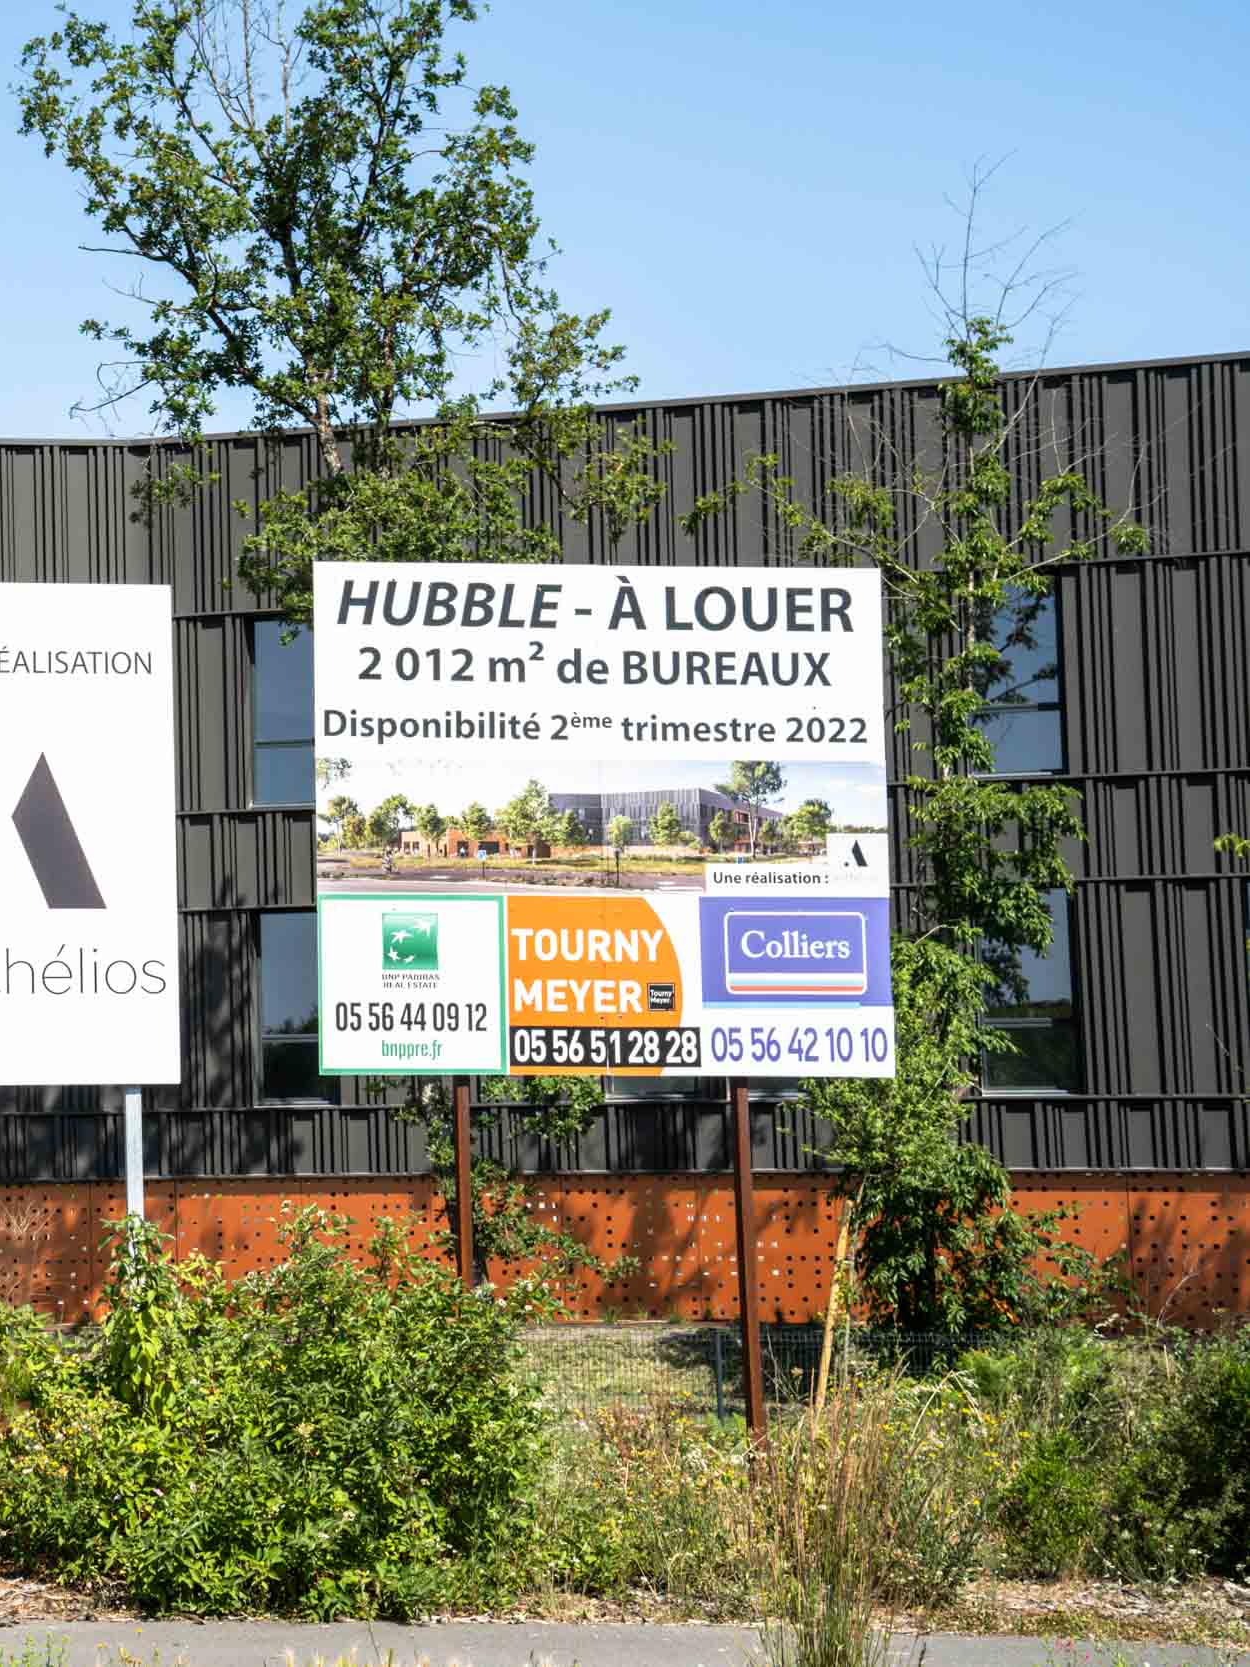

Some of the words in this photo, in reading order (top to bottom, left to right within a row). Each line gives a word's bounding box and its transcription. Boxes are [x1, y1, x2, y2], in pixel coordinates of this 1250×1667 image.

[337, 579, 562, 629] HUBBLE
[608, 575, 647, 631] À
[665, 586, 854, 632] LOUER
[358, 646, 382, 681] 2
[395, 646, 474, 682] 012
[556, 648, 609, 685] de
[622, 650, 832, 687] BUREAUX
[323, 708, 541, 745] Disponibilité
[621, 713, 776, 743] trimestre
[786, 716, 868, 744] 2022
[713, 871, 742, 885] Une
[745, 870, 821, 885] réalisation
[510, 928, 663, 962] TOURNY
[741, 929, 852, 960] Colliers
[513, 979, 643, 1013] MEYER
[335, 1001, 362, 1032] 05
[368, 1001, 394, 1032] 56
[400, 1002, 427, 1032] 44
[432, 1002, 459, 1032] 09
[465, 1002, 487, 1032] 12
[381, 1040, 443, 1061] bnppre.fr
[514, 1029, 547, 1063] 05
[552, 1029, 585, 1063] 56
[590, 1029, 621, 1064] 51
[628, 1030, 660, 1064] 28
[665, 1030, 698, 1065] 28
[711, 1026, 744, 1063] 05
[750, 1026, 781, 1063] 56
[787, 1026, 819, 1063] 42
[825, 1026, 853, 1063] 10
[860, 1026, 888, 1063] 10
